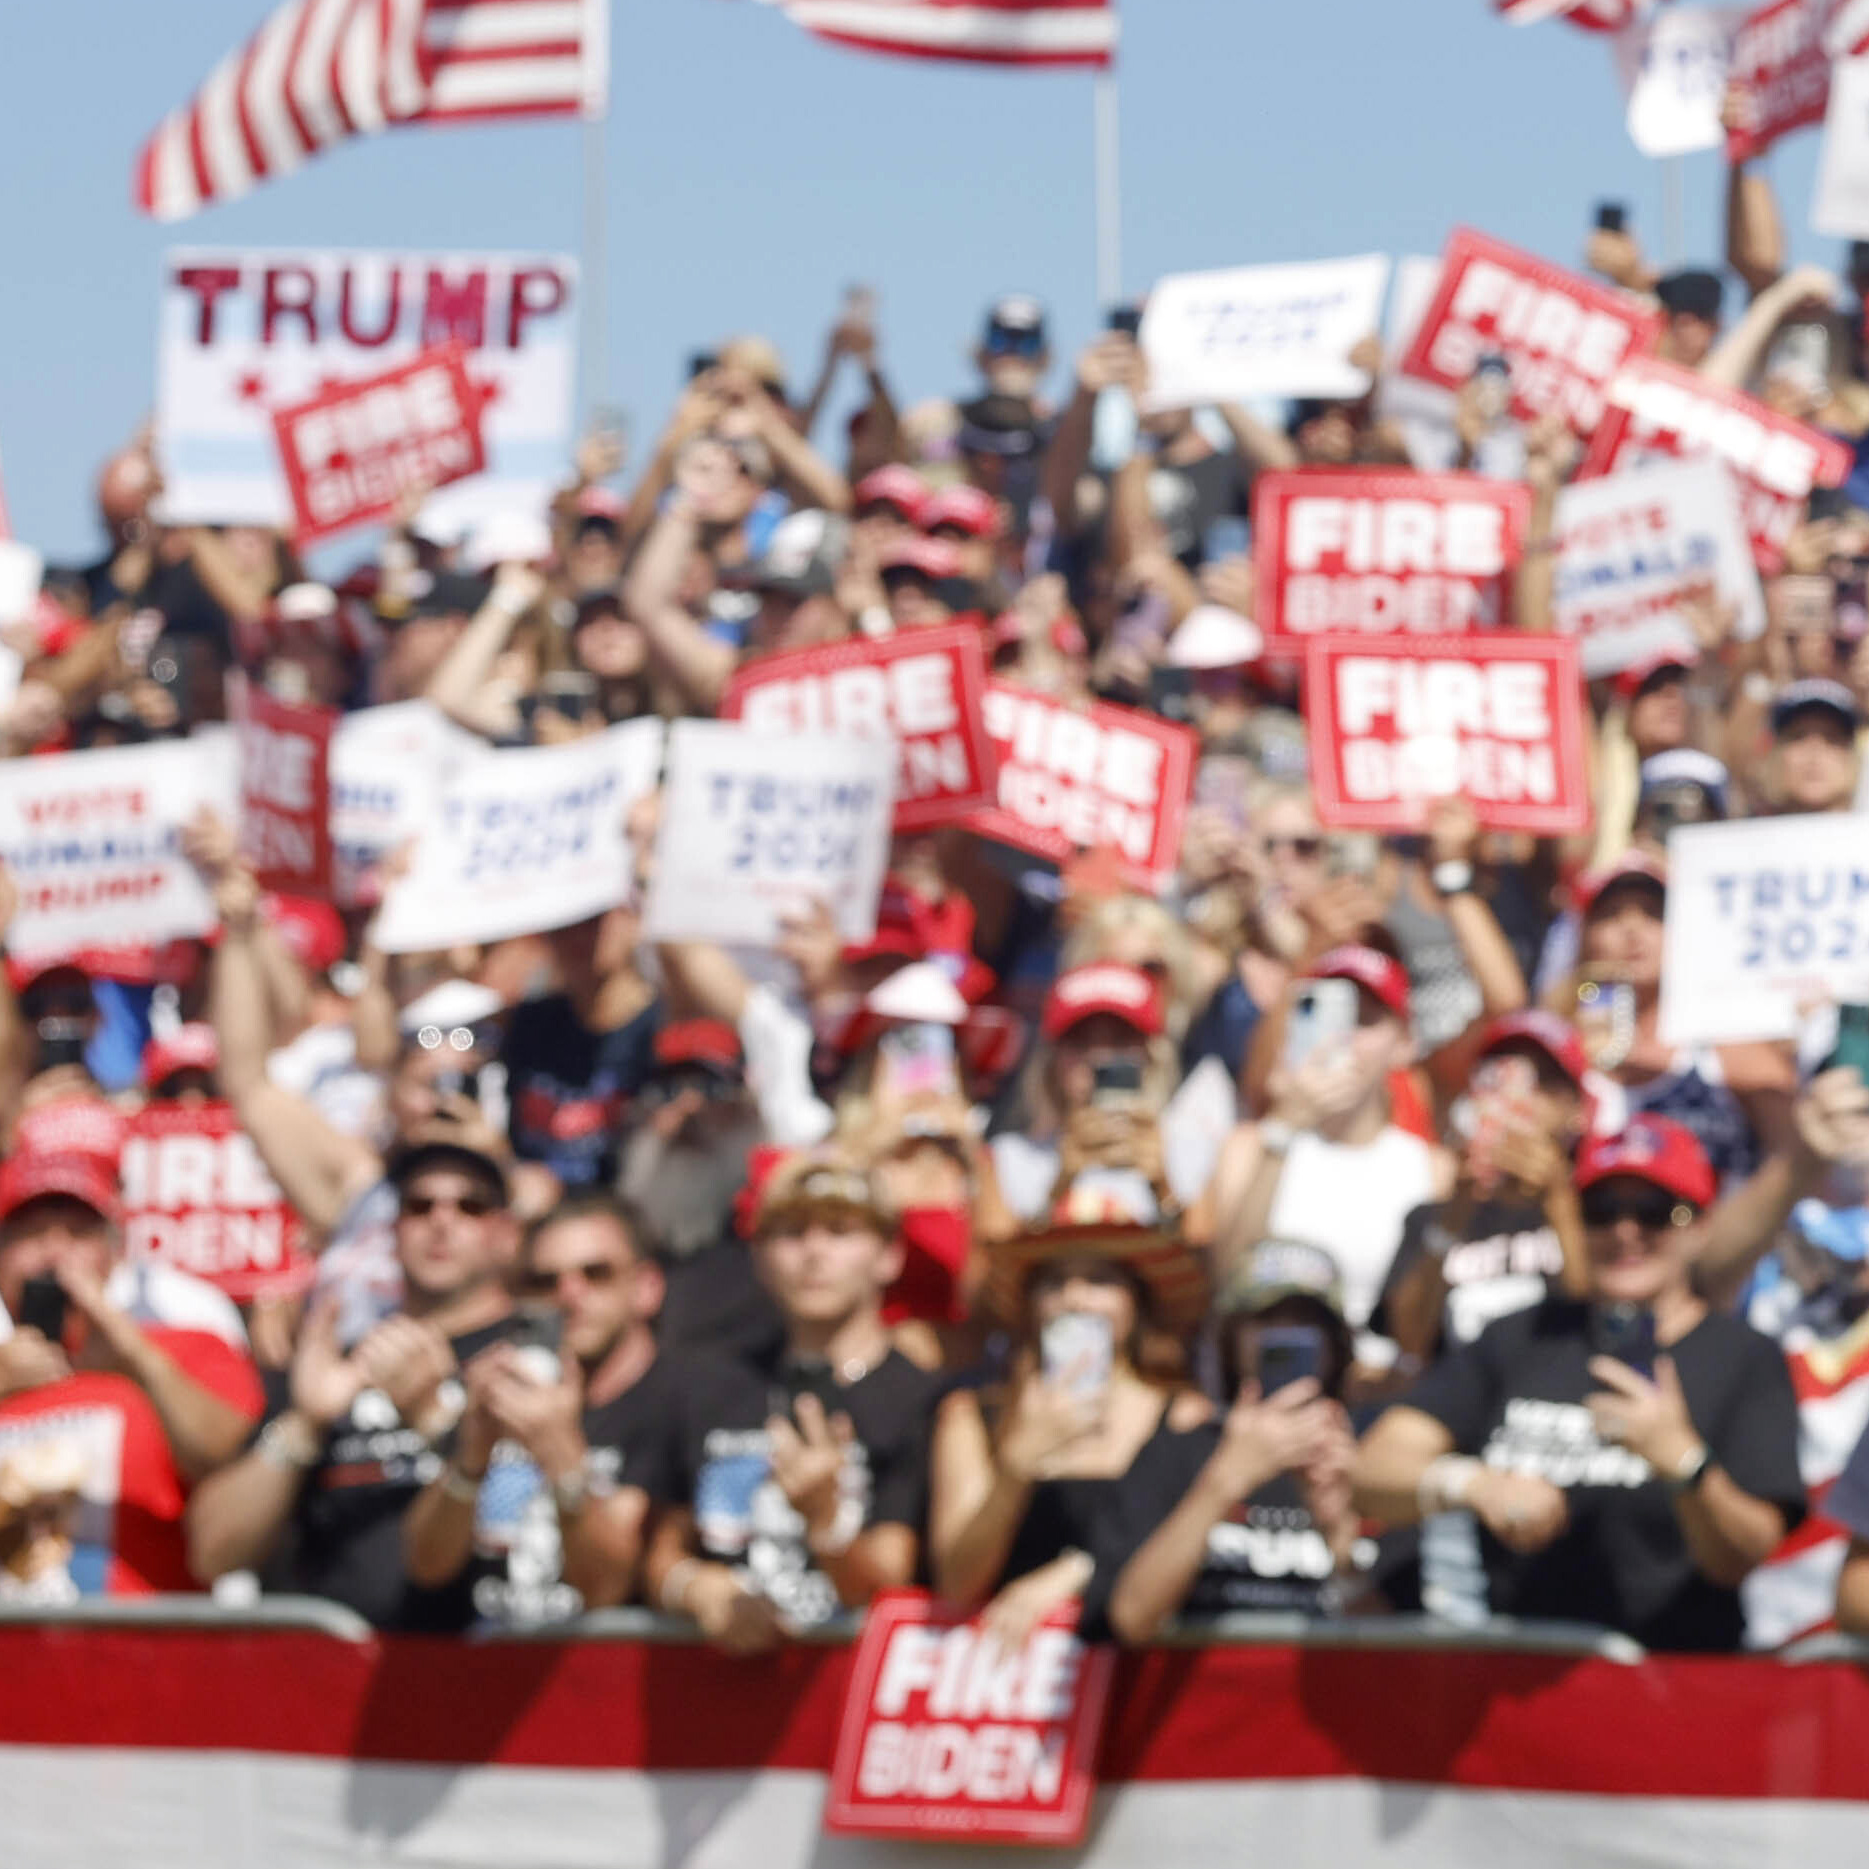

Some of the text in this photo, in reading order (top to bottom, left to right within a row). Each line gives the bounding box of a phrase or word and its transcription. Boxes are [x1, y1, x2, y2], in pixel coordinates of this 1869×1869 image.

[173, 266, 571, 350] TRUMP
[1449, 259, 1634, 378] FIRE
[293, 363, 466, 458] FIRE
[1427, 320, 1609, 430] BDEN
[1284, 497, 1504, 575] FIRE
[742, 653, 959, 736] FIRE
[1334, 657, 1551, 739] FIRE
[980, 687, 1162, 806] FIRE
[125, 1213, 285, 1270] DEN
[857, 1719, 1066, 1804] BIDEN
